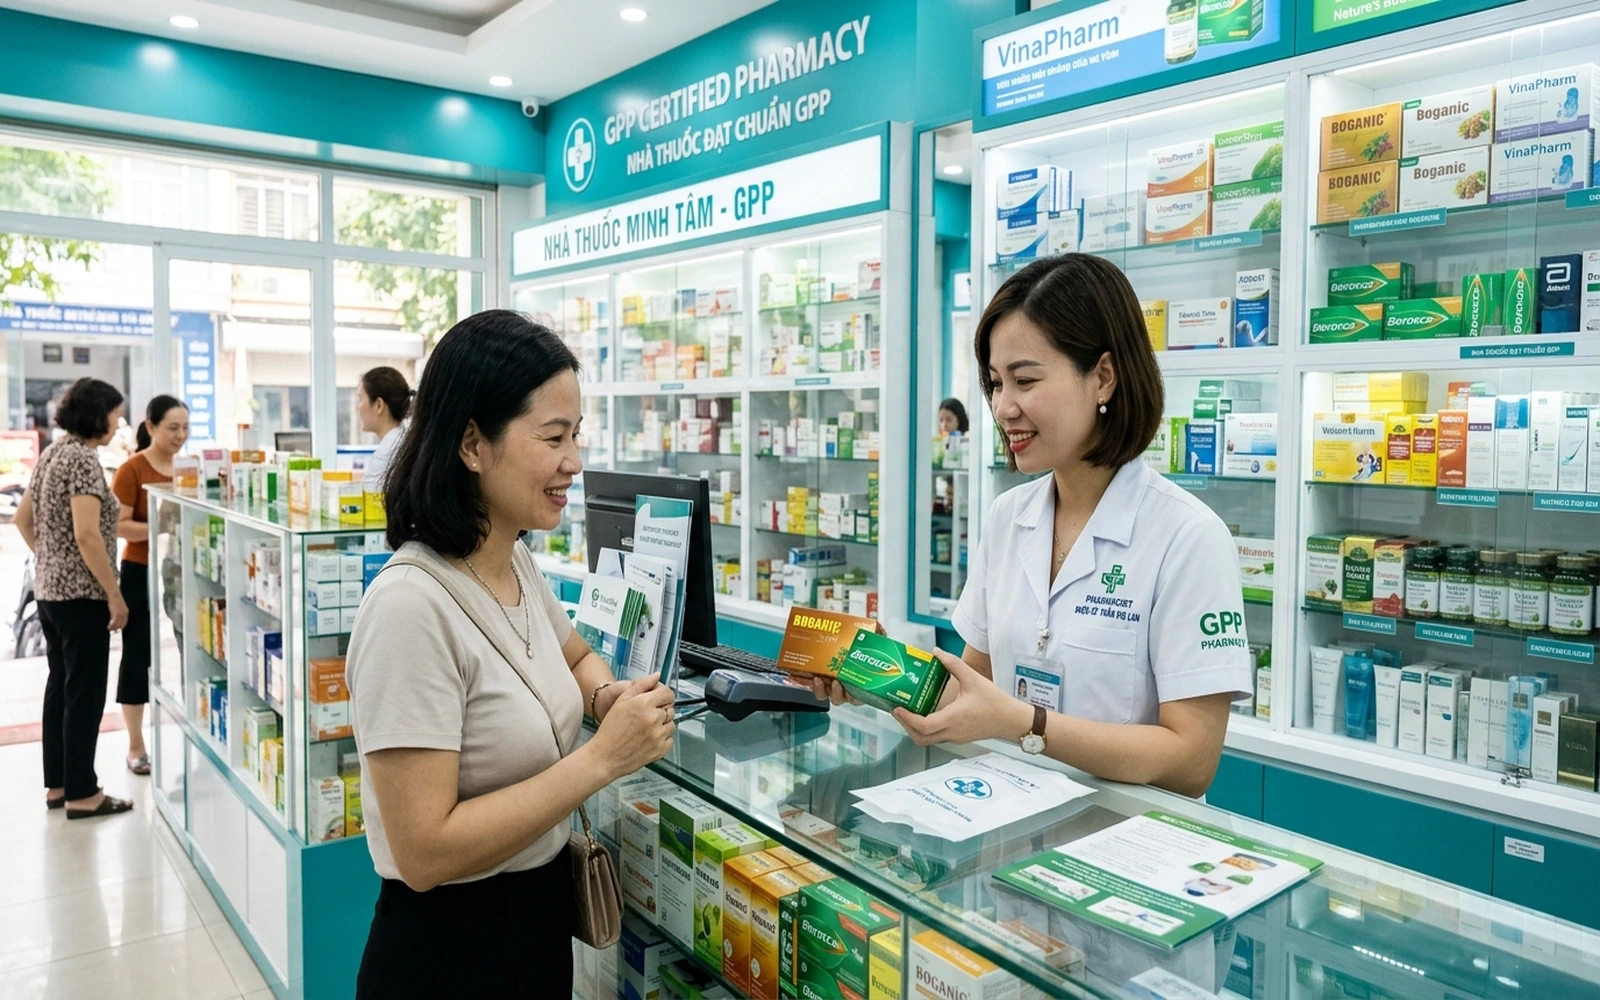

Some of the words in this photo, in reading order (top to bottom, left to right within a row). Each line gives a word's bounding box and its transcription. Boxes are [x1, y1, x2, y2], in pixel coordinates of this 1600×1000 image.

[997, 16, 1119, 67] VinaPharm
[604, 109, 636, 145] GPP
[638, 71, 731, 133] CERTIFIED
[735, 15, 871, 99] PHARMACY
[1331, 113, 1384, 134] BOGANIC
[1417, 101, 1469, 121] Boganic
[627, 140, 653, 176] NHÀ
[655, 126, 702, 167] THUỐC
[703, 121, 732, 154] ĐẠT
[734, 95, 791, 142] CHUẨN
[794, 89, 831, 122] GPP
[1504, 142, 1572, 160] VinaPharm
[1328, 171, 1381, 190] BOGANIC
[544, 225, 570, 261] NHÀ
[575, 209, 620, 254] THUỐC
[627, 206, 669, 244] MINH
[676, 193, 713, 233] TÂM
[734, 180, 774, 221] GPP
[1200, 611, 1242, 636] GPP
